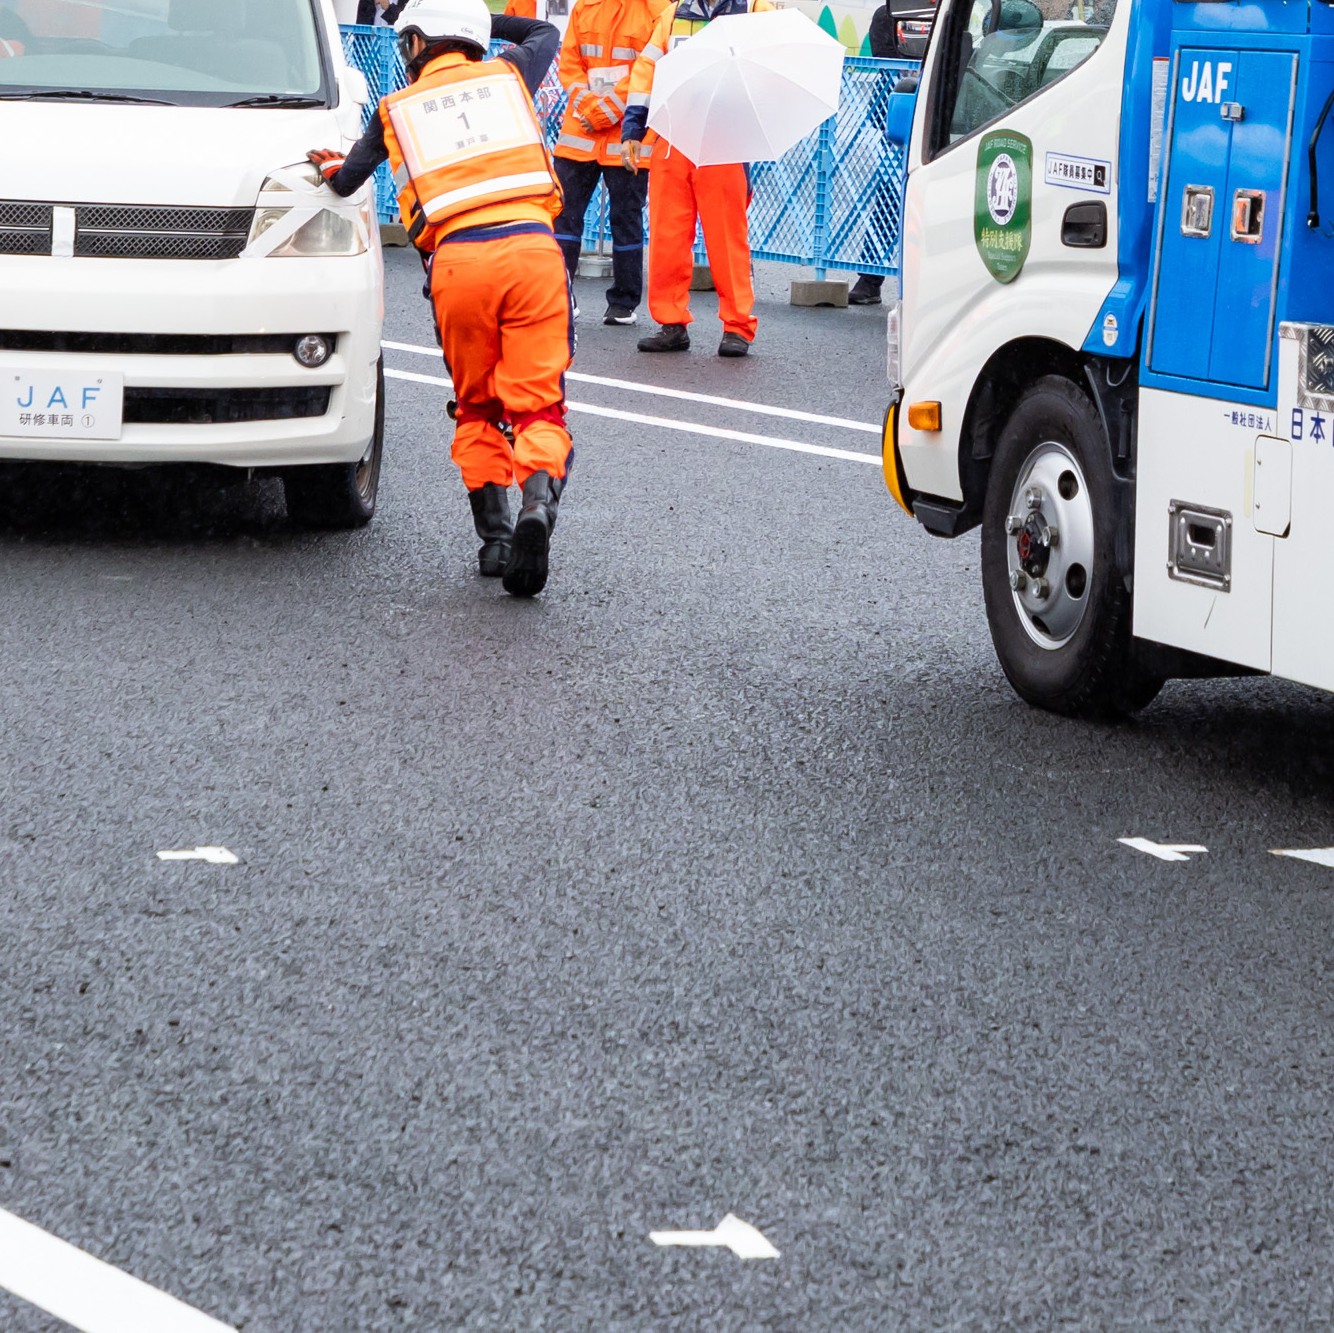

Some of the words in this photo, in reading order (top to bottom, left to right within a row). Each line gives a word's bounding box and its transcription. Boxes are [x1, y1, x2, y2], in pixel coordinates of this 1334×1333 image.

[1181, 61, 1233, 104] JAF
[422, 86, 491, 114] 関西本部
[457, 112, 470, 129] 1
[981, 227, 1023, 251] 特別支援隊
[17, 386, 101, 409] JAF
[19, 413, 74, 426] 研修車両
[1223, 412, 1272, 432] 一般社団法人
